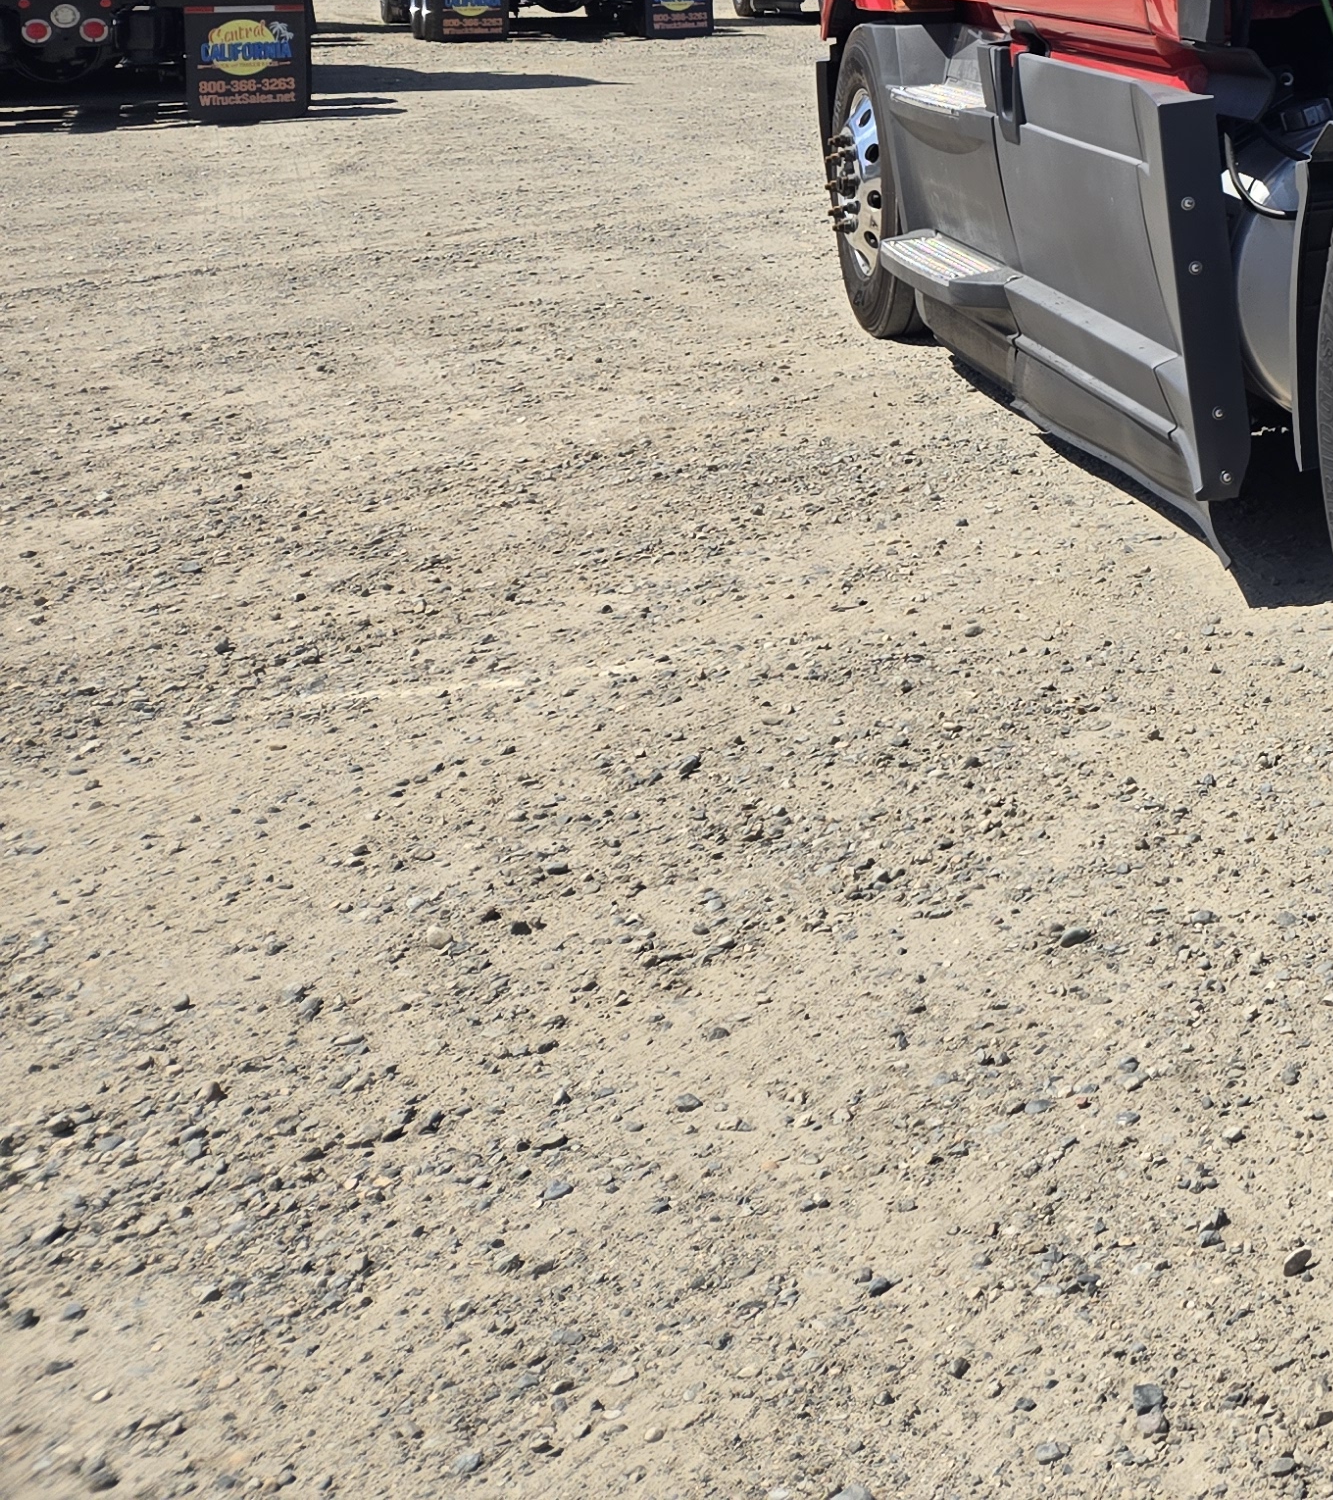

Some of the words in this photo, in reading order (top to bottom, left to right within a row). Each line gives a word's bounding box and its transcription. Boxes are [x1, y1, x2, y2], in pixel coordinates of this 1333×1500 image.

[208, 19, 266, 43] Central
[200, 40, 292, 63] CALIFORNIA
[199, 77, 295, 93] 800-366-3263
[199, 92, 295, 106] WTruckSales.net
